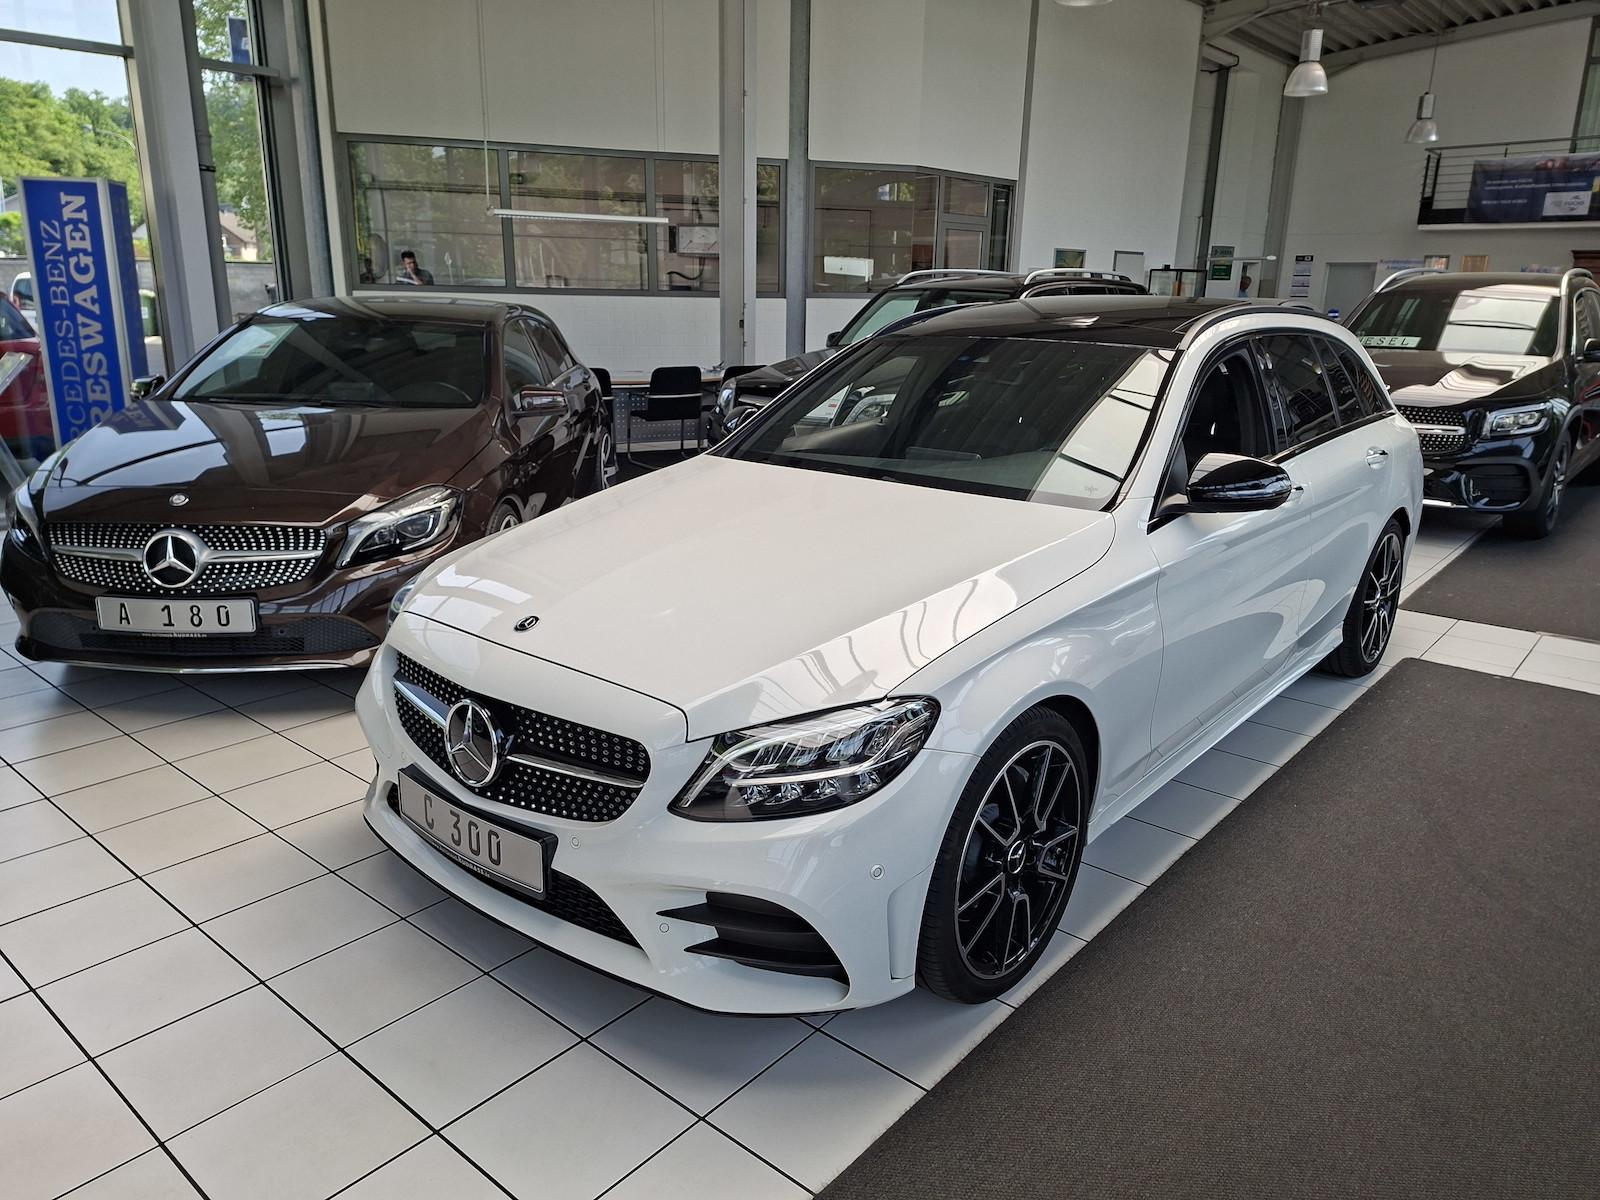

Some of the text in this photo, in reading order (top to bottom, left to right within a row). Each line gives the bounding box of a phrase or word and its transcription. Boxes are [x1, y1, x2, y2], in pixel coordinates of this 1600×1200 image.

[40, 220, 87, 440] RCEDES-BENZ
[60, 192, 113, 427] RESWAGEN
[1360, 336, 1409, 346] IESEL
[119, 602, 231, 627] A 180
[424, 794, 435, 830] C
[450, 809, 502, 866] 300
